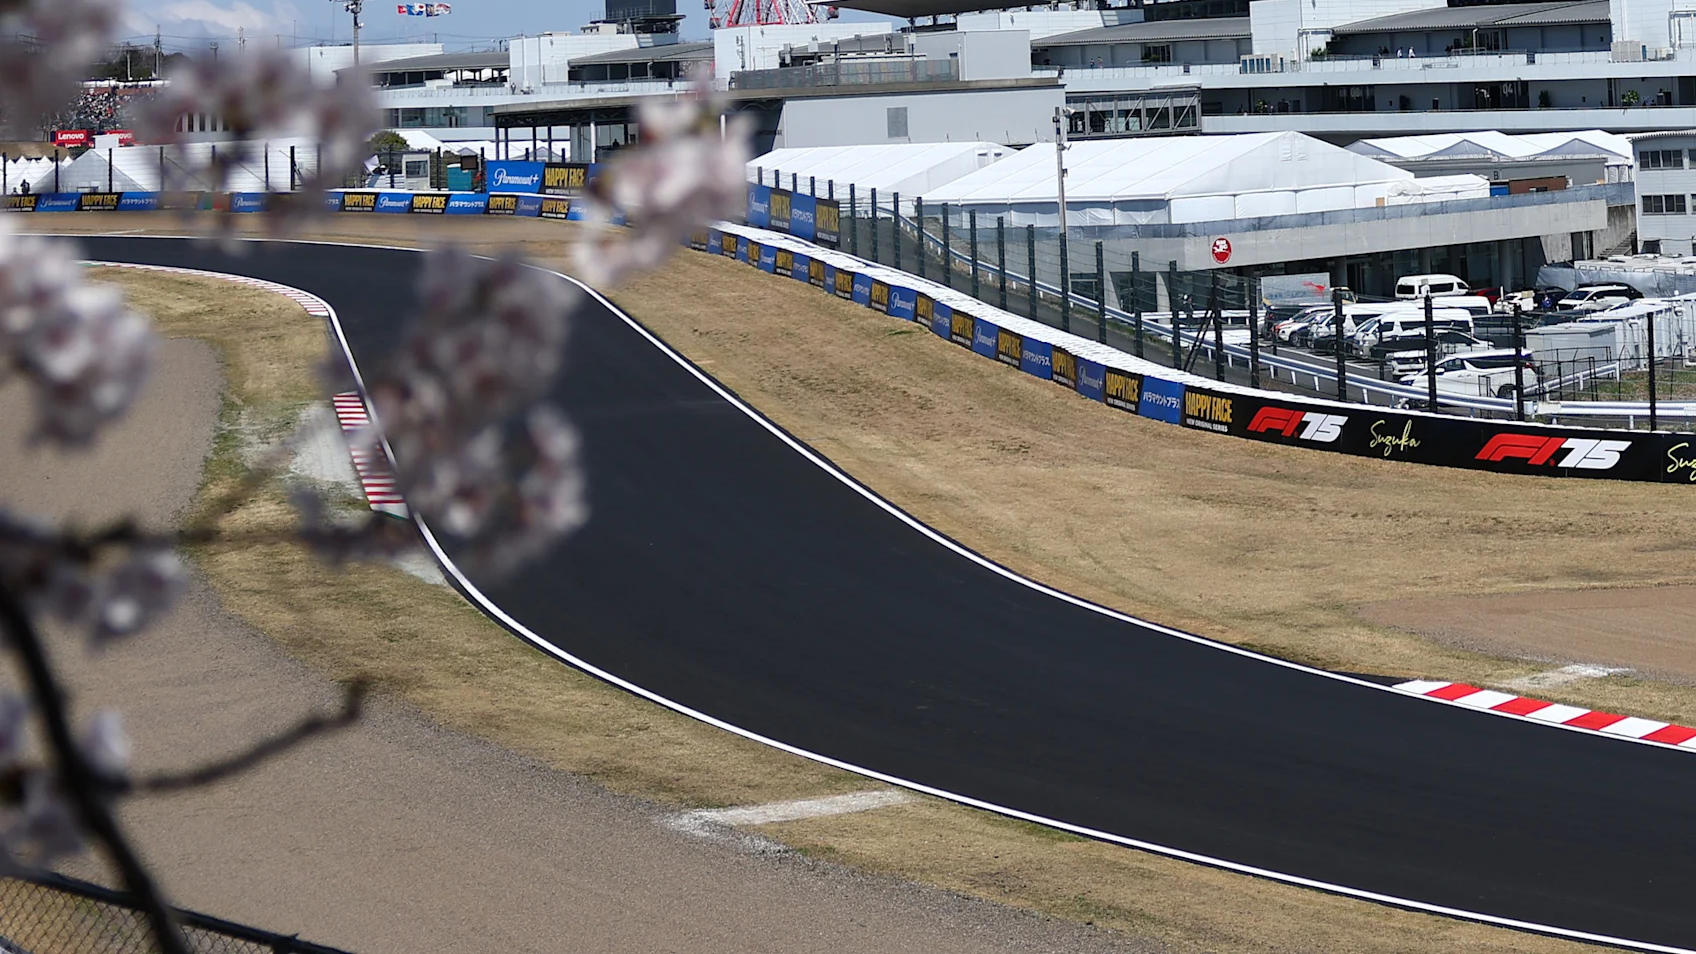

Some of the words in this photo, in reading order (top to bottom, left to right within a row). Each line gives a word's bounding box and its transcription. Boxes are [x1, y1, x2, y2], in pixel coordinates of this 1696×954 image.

[493, 168, 539, 186] Paramount+
[545, 168, 568, 187] HAPPY
[569, 169, 584, 187] FACE
[1493, 170, 1499, 180] B
[82, 195, 103, 206] HAPPY
[103, 195, 118, 206] FACE
[345, 195, 362, 206] HAPPY
[363, 195, 375, 206] FACE
[379, 196, 409, 208] Paramount+
[413, 196, 431, 207] HAPPY
[432, 196, 446, 208] FACE
[490, 197, 504, 208] HAPPY
[504, 197, 516, 209] FACE
[1106, 371, 1126, 399] HAPPY
[1126, 377, 1139, 402] FACE
[1143, 391, 1181, 409] パラマウントプラス
[1185, 391, 1212, 420] HAPPY
[1212, 396, 1232, 423] FACE
[1186, 418, 1195, 426] NEW
[1195, 420, 1212, 429] ORIGINAL
[1212, 424, 1228, 432] SERIES
[1370, 419, 1421, 457] Suzuka
